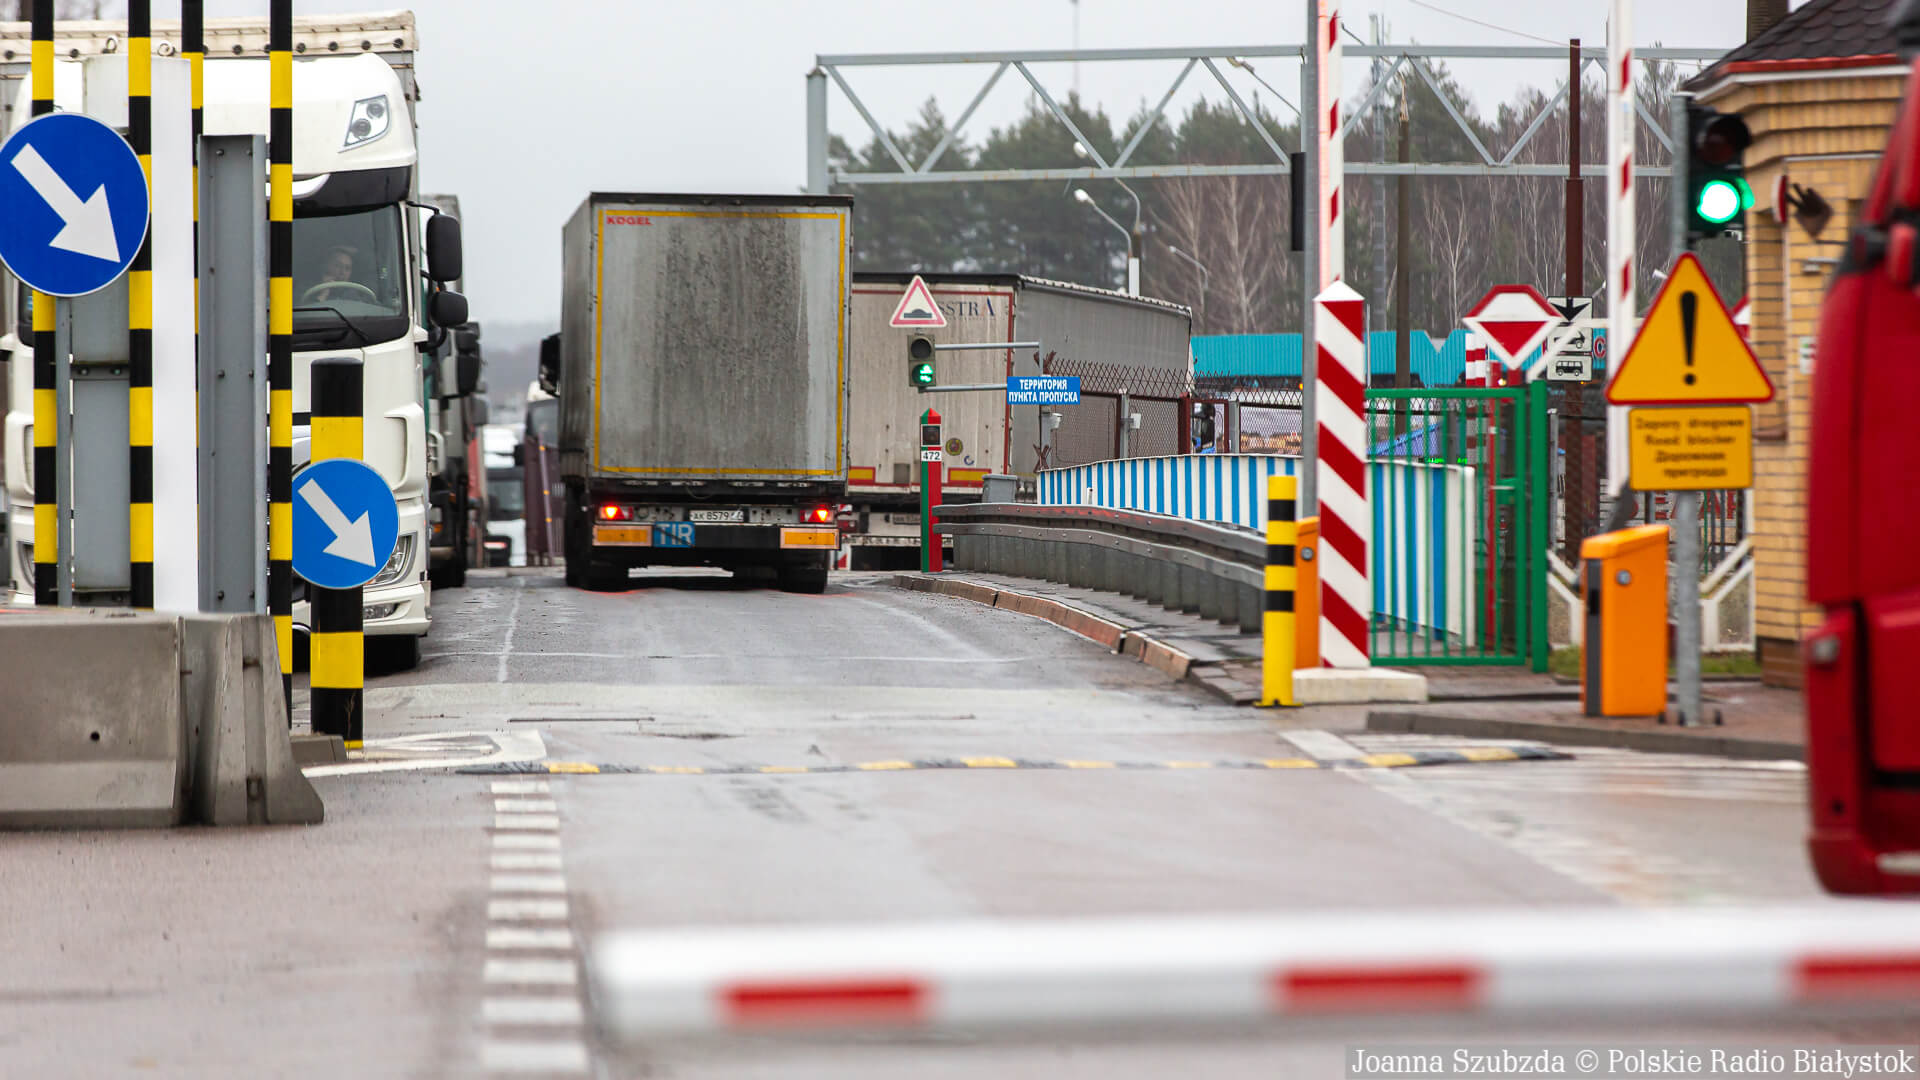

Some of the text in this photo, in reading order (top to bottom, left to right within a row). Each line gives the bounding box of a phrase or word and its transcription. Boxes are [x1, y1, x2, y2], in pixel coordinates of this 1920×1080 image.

[1019, 379, 1067, 390] ТЕРРИТОРИЯ
[1009, 392, 1078, 402] ПУНКТА ПРОПУСКА
[923, 451, 940, 460] 472
[656, 523, 693, 545] TIR
